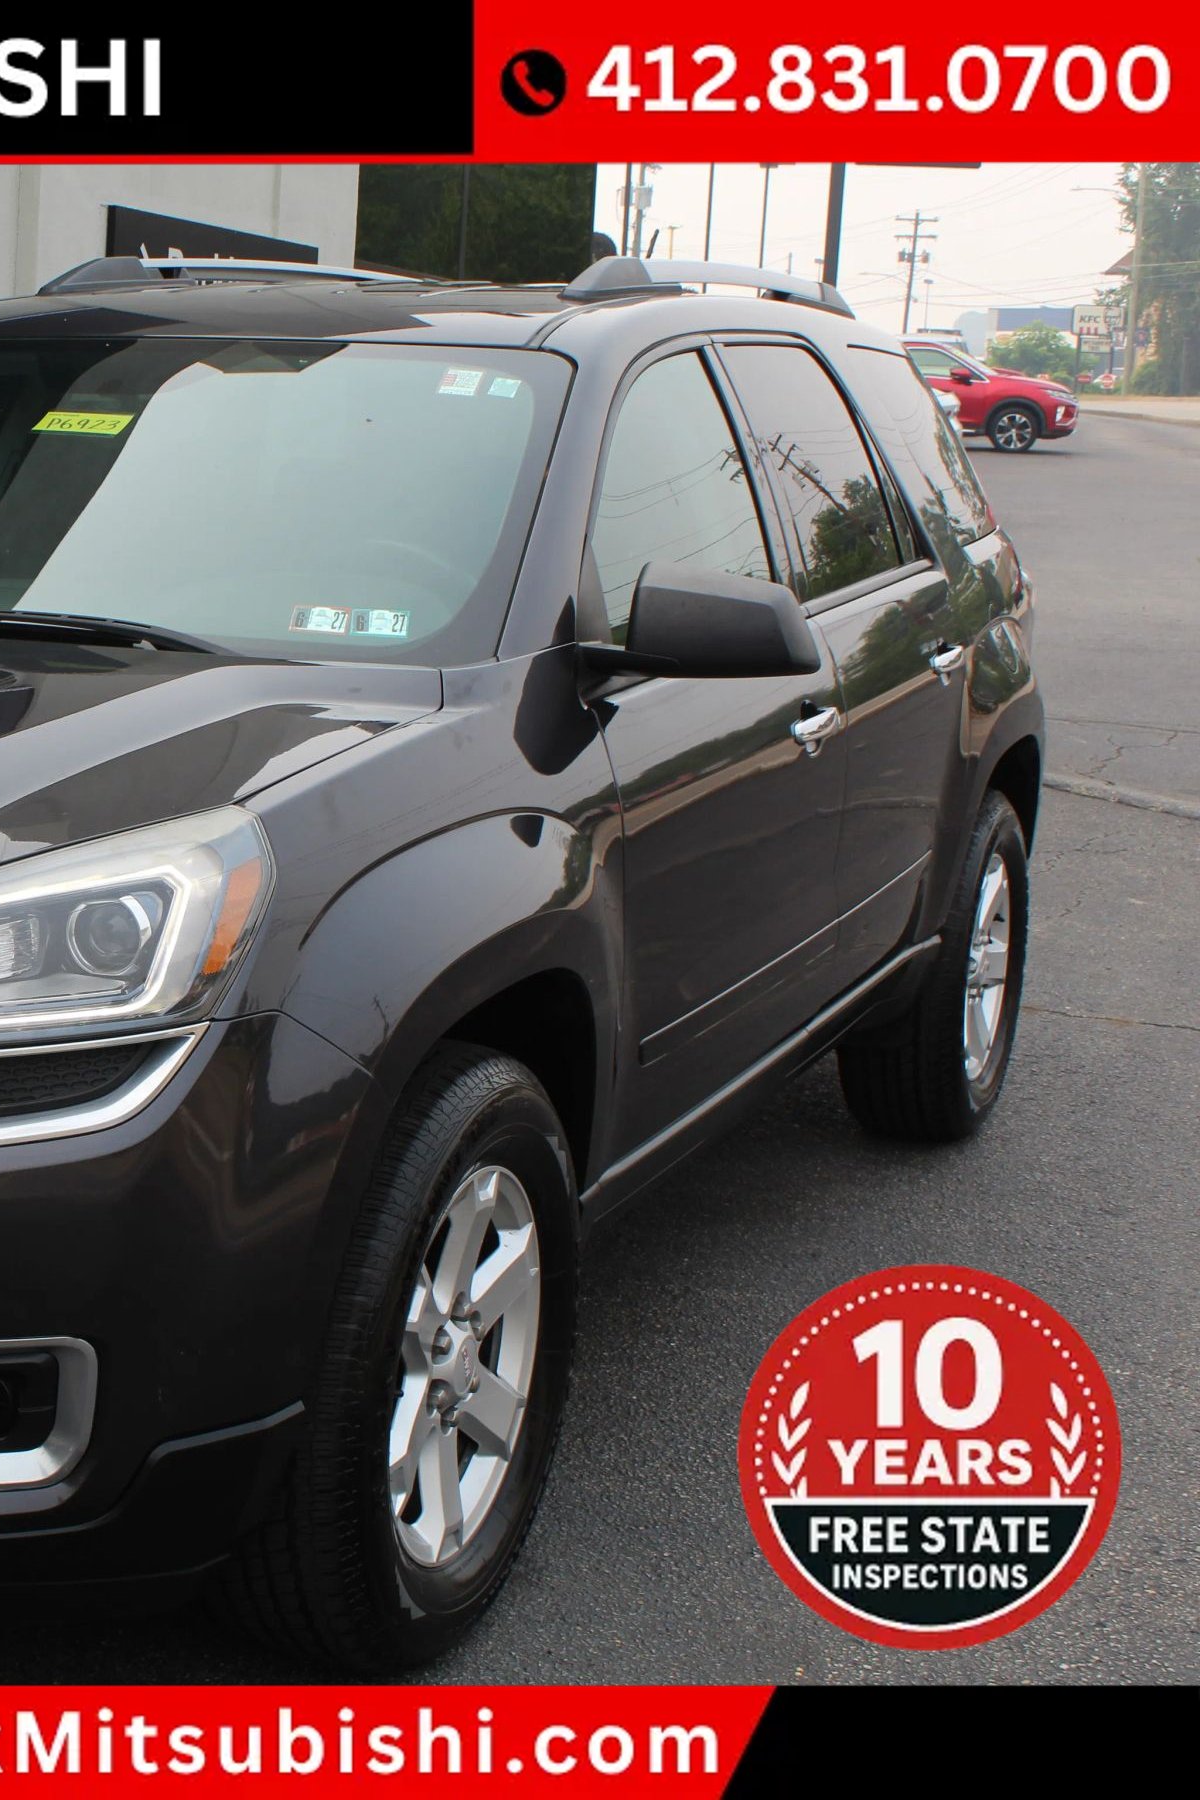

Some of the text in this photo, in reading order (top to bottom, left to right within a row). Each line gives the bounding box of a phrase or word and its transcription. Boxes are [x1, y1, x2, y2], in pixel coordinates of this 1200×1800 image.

[1079, 315, 1101, 323] KFC
[331, 612, 347, 631] 27
[391, 613, 406, 633] 27
